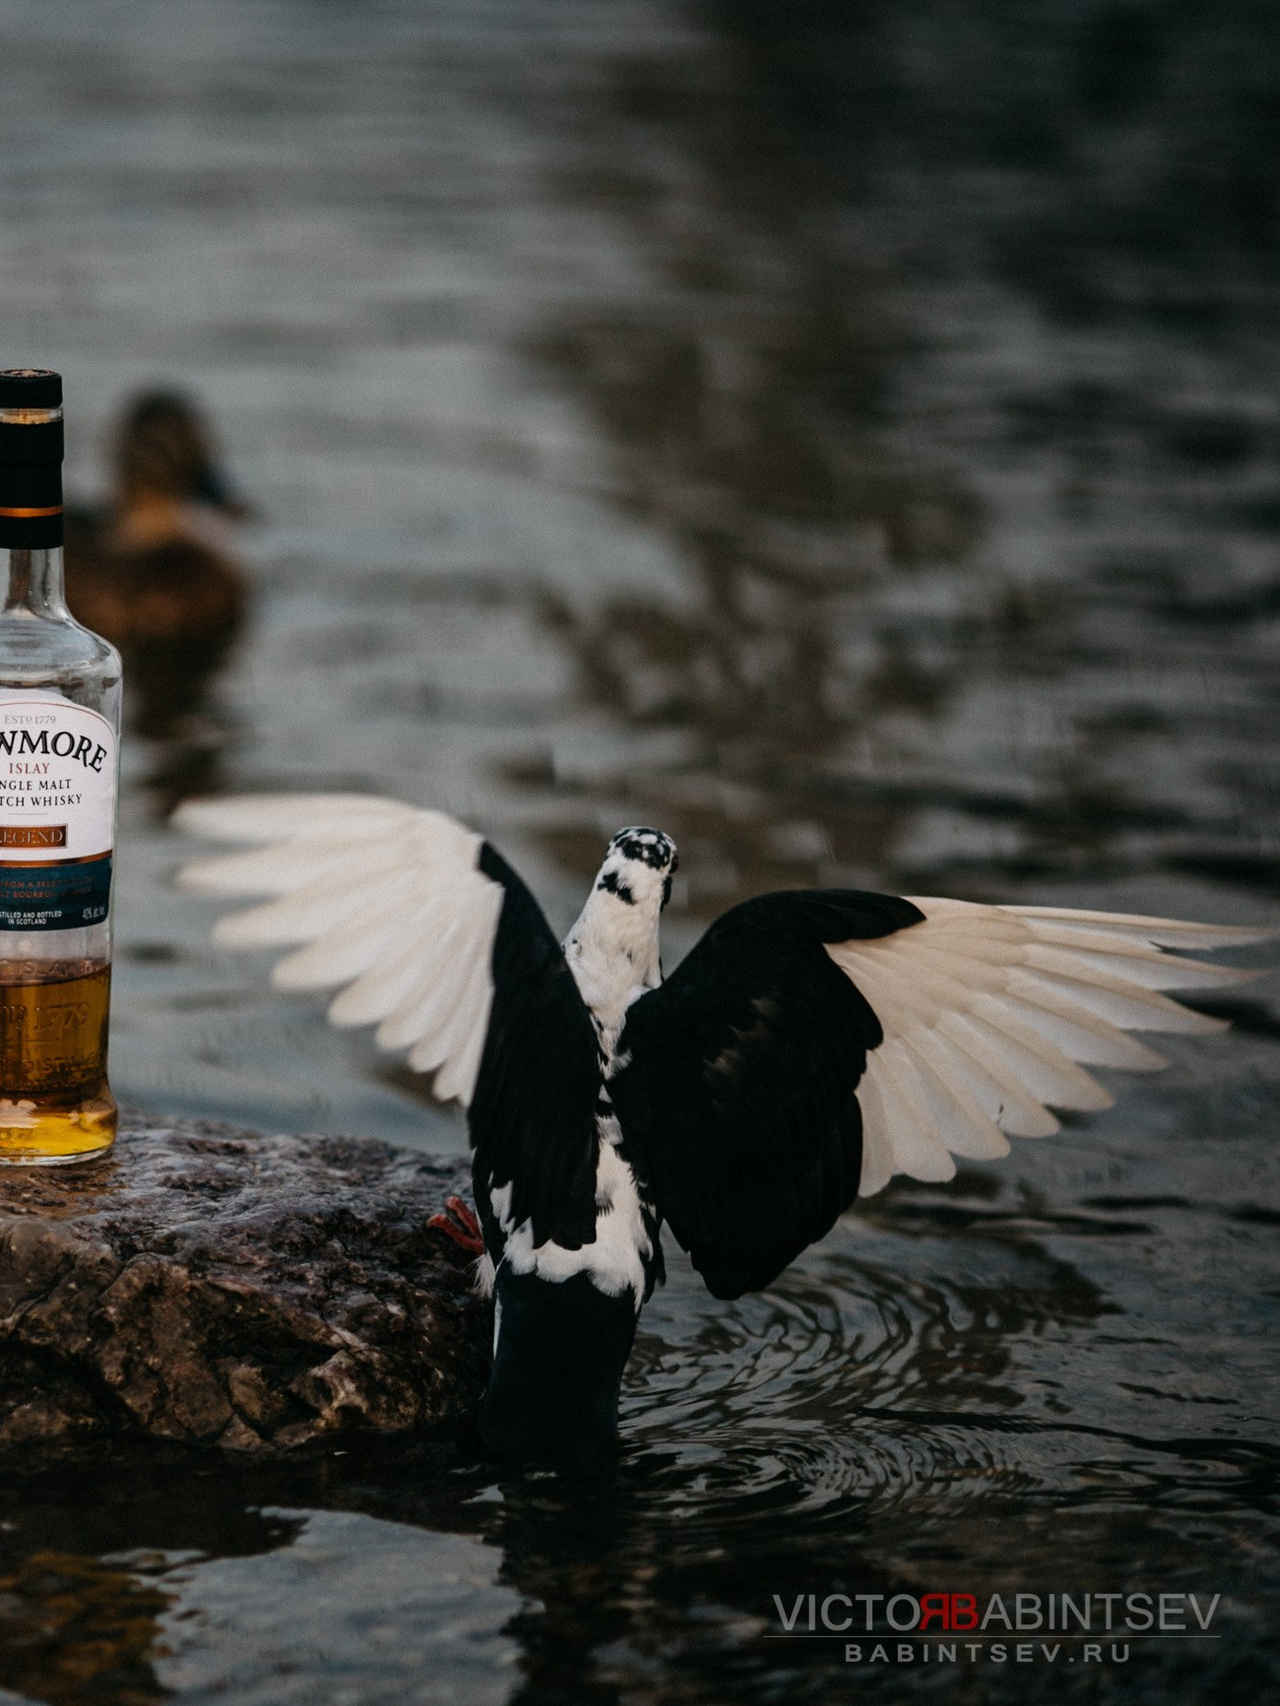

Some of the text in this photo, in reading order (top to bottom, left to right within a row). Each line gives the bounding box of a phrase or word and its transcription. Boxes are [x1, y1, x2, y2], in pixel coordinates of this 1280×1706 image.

[35, 715, 56, 724] 1779
[9, 763, 50, 774] ISLAY
[39, 779, 72, 791] MALT
[30, 793, 82, 807] WHISKY
[22, 911, 35, 919] AND
[37, 910, 62, 918] BOTTLED
